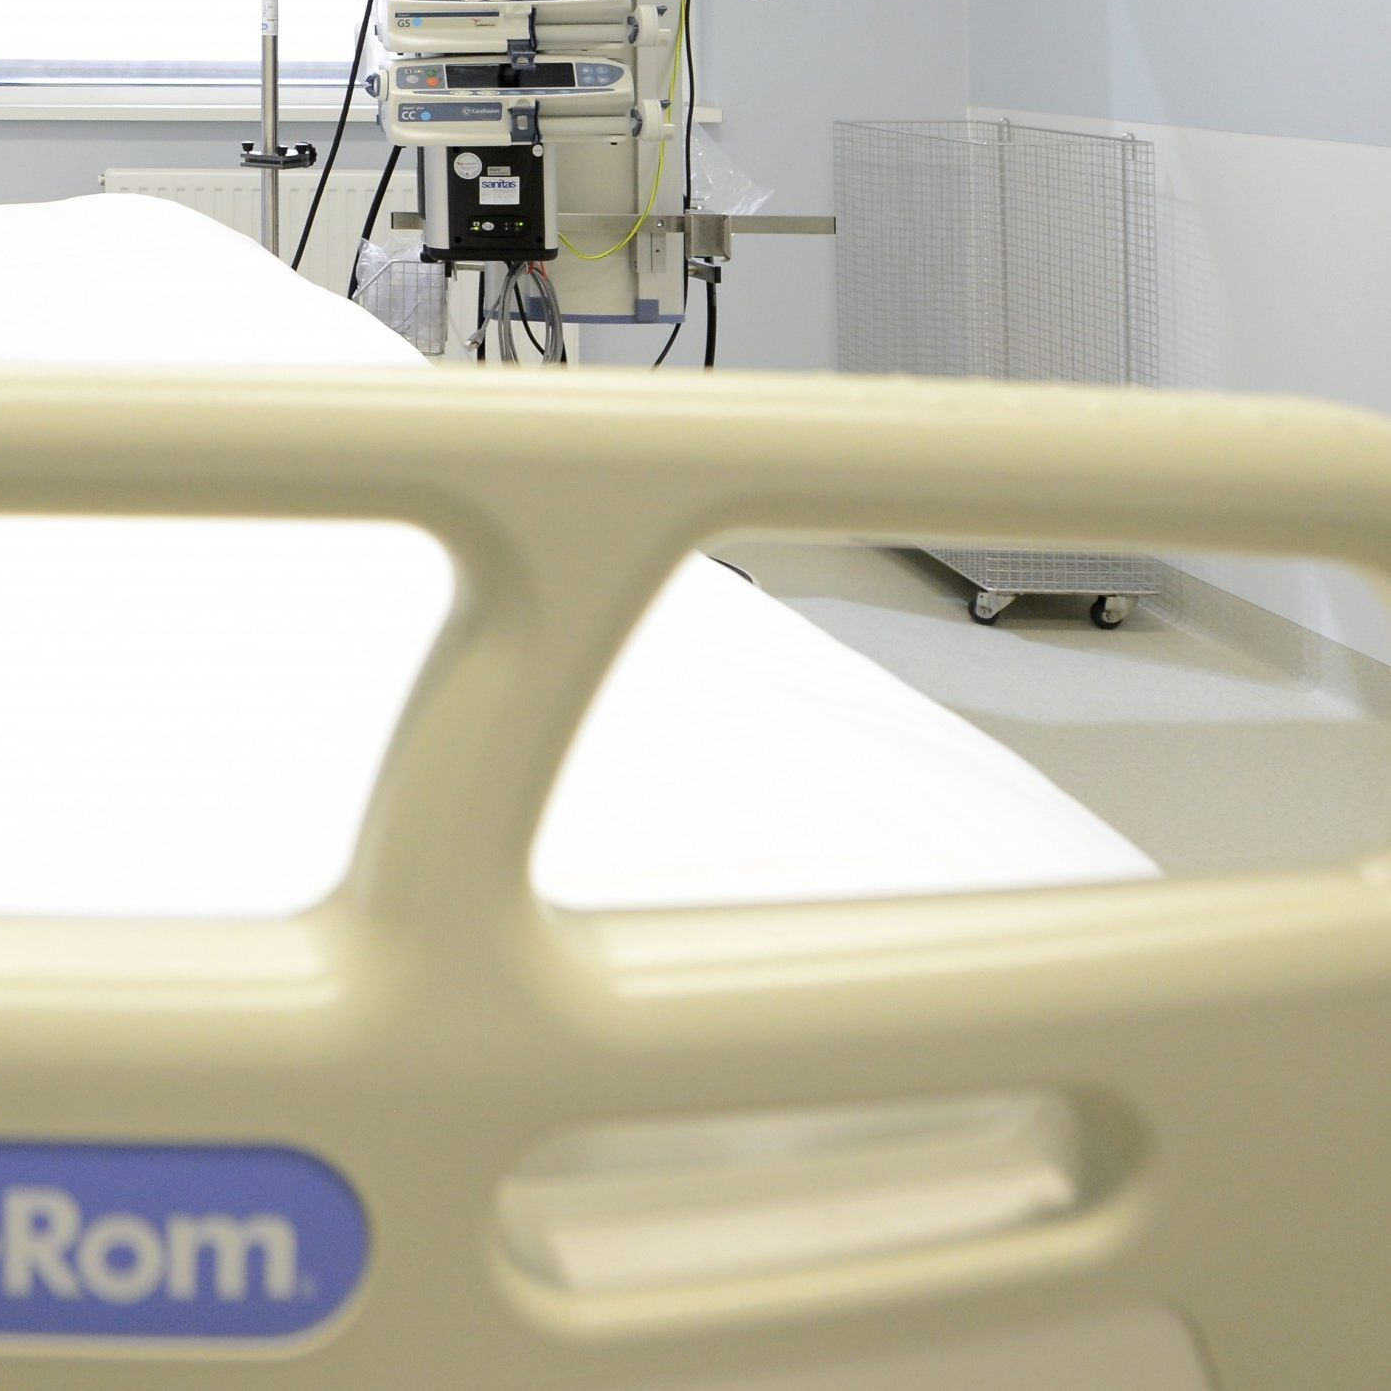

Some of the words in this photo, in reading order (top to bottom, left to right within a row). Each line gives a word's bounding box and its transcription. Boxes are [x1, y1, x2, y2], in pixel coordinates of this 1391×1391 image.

[397, 19, 410, 27] GS
[401, 111, 416, 120] CC
[482, 179, 516, 189] sanitas
